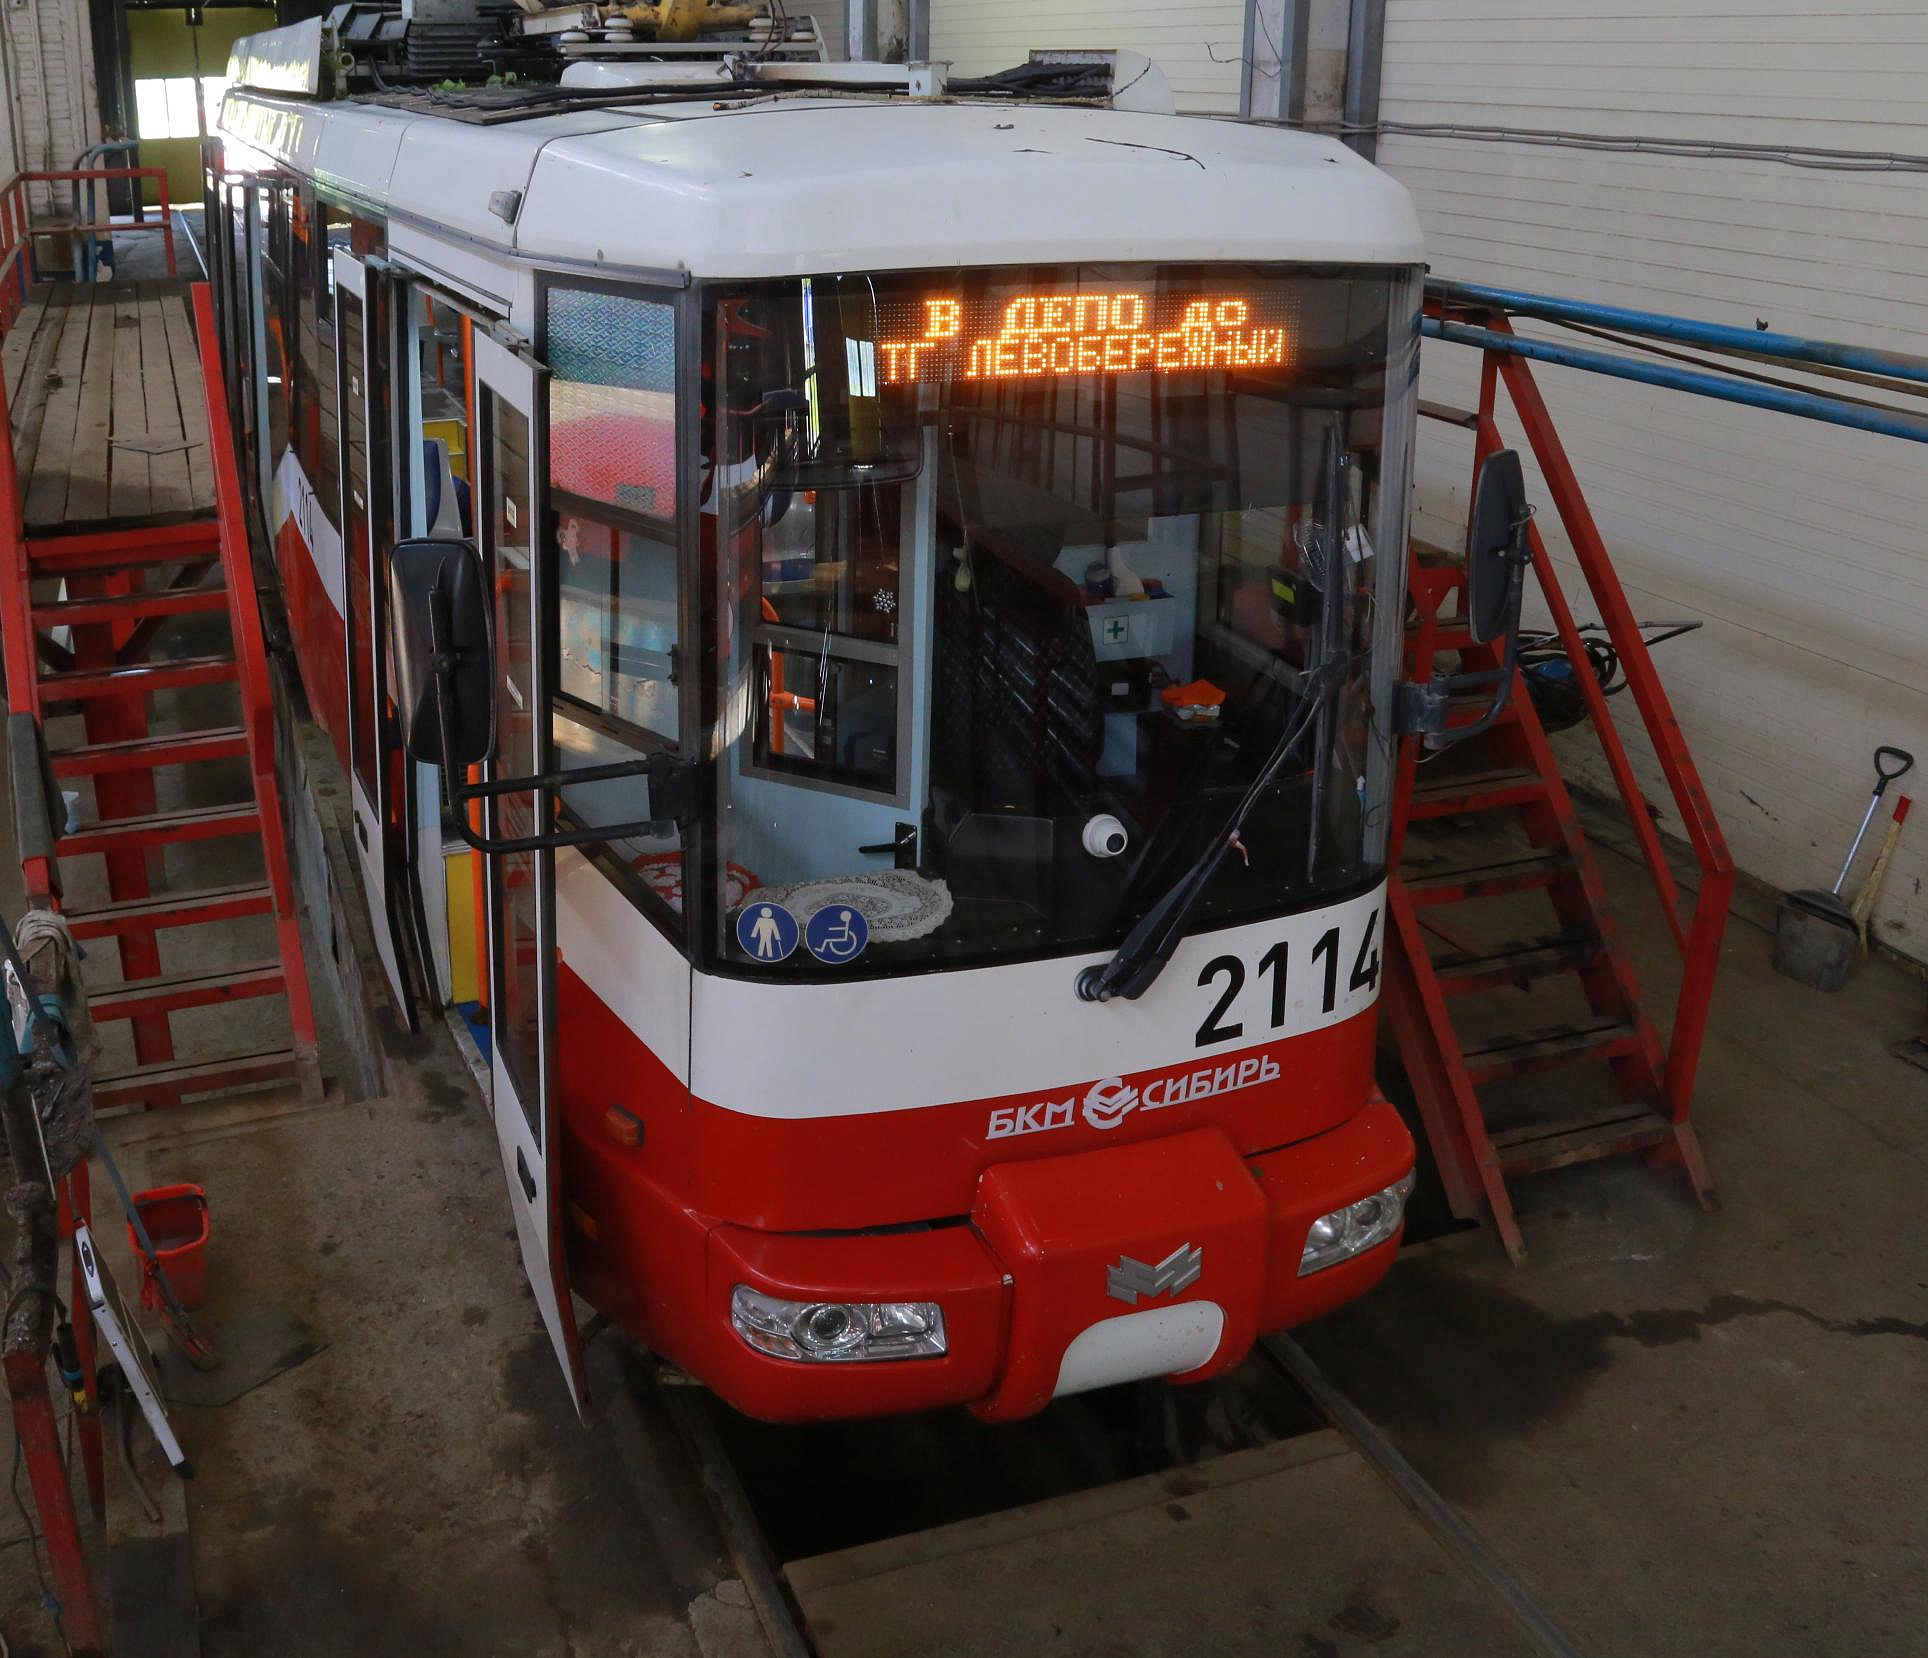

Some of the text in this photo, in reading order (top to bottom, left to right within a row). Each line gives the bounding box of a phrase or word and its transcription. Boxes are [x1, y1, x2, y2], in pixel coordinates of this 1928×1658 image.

[924, 299, 961, 338] В
[999, 294, 1144, 340] ДЕПО
[881, 341, 936, 381] ТГ
[1193, 907, 1381, 1048] 2114
[985, 1054, 1281, 1140] БКМ СИБИРЬ
